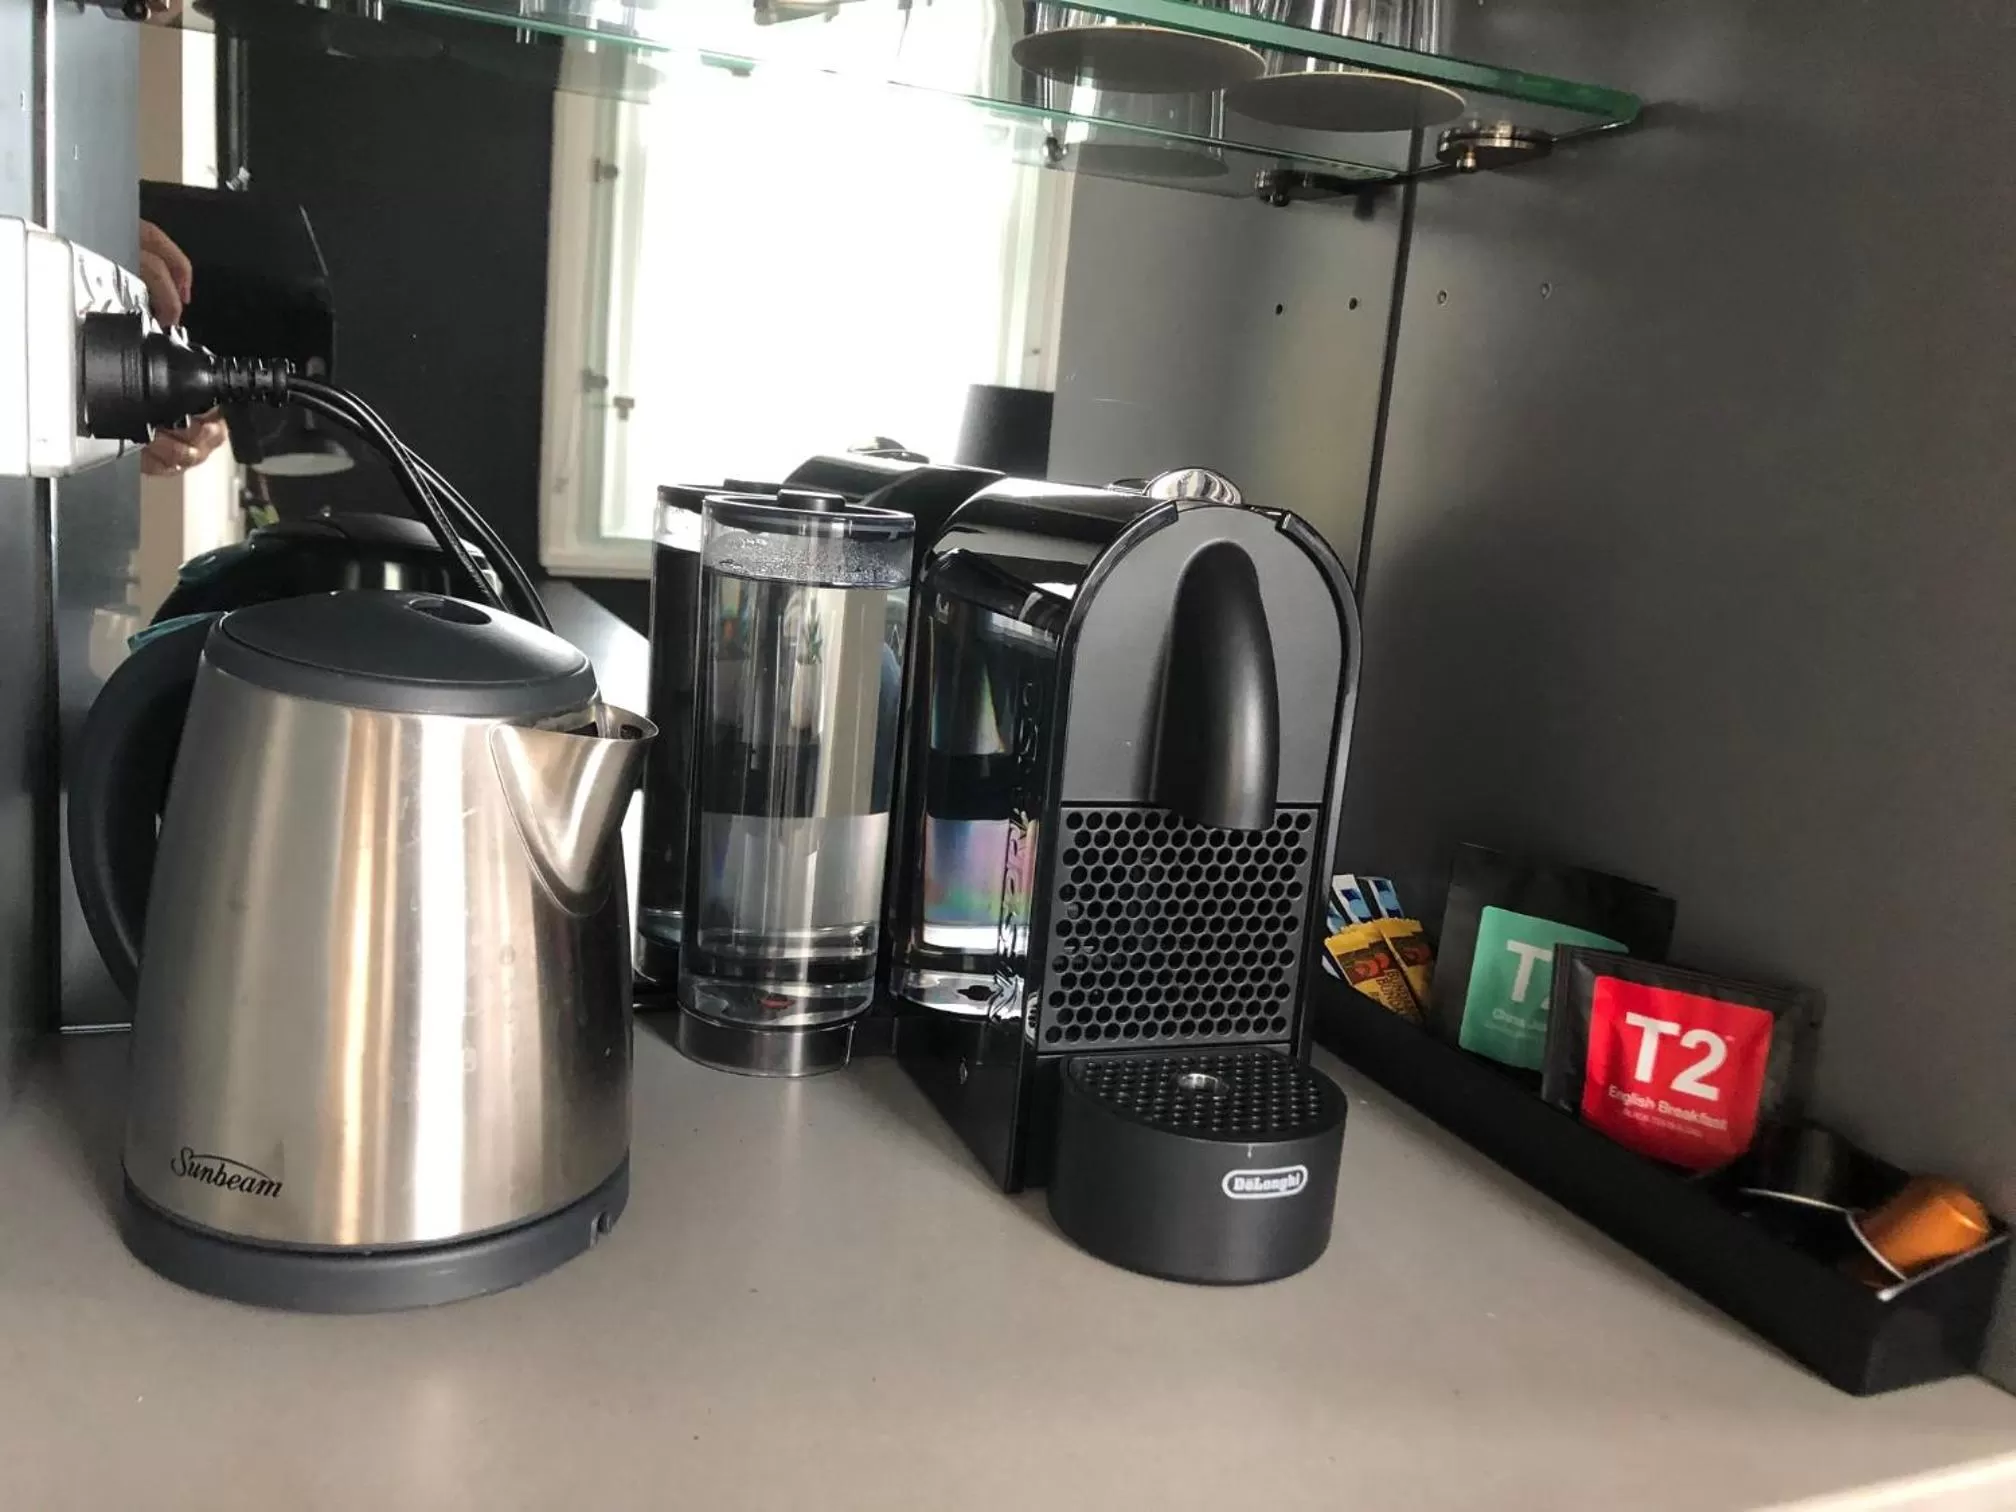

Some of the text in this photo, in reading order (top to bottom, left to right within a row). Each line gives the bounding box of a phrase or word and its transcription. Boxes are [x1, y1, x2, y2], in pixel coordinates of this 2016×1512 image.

[1625, 1011, 1727, 1101] T2
[1608, 1083, 1656, 1109] English
[1657, 1099, 1728, 1130] Breakfast
[170, 1147, 282, 1198] Sunbeam
